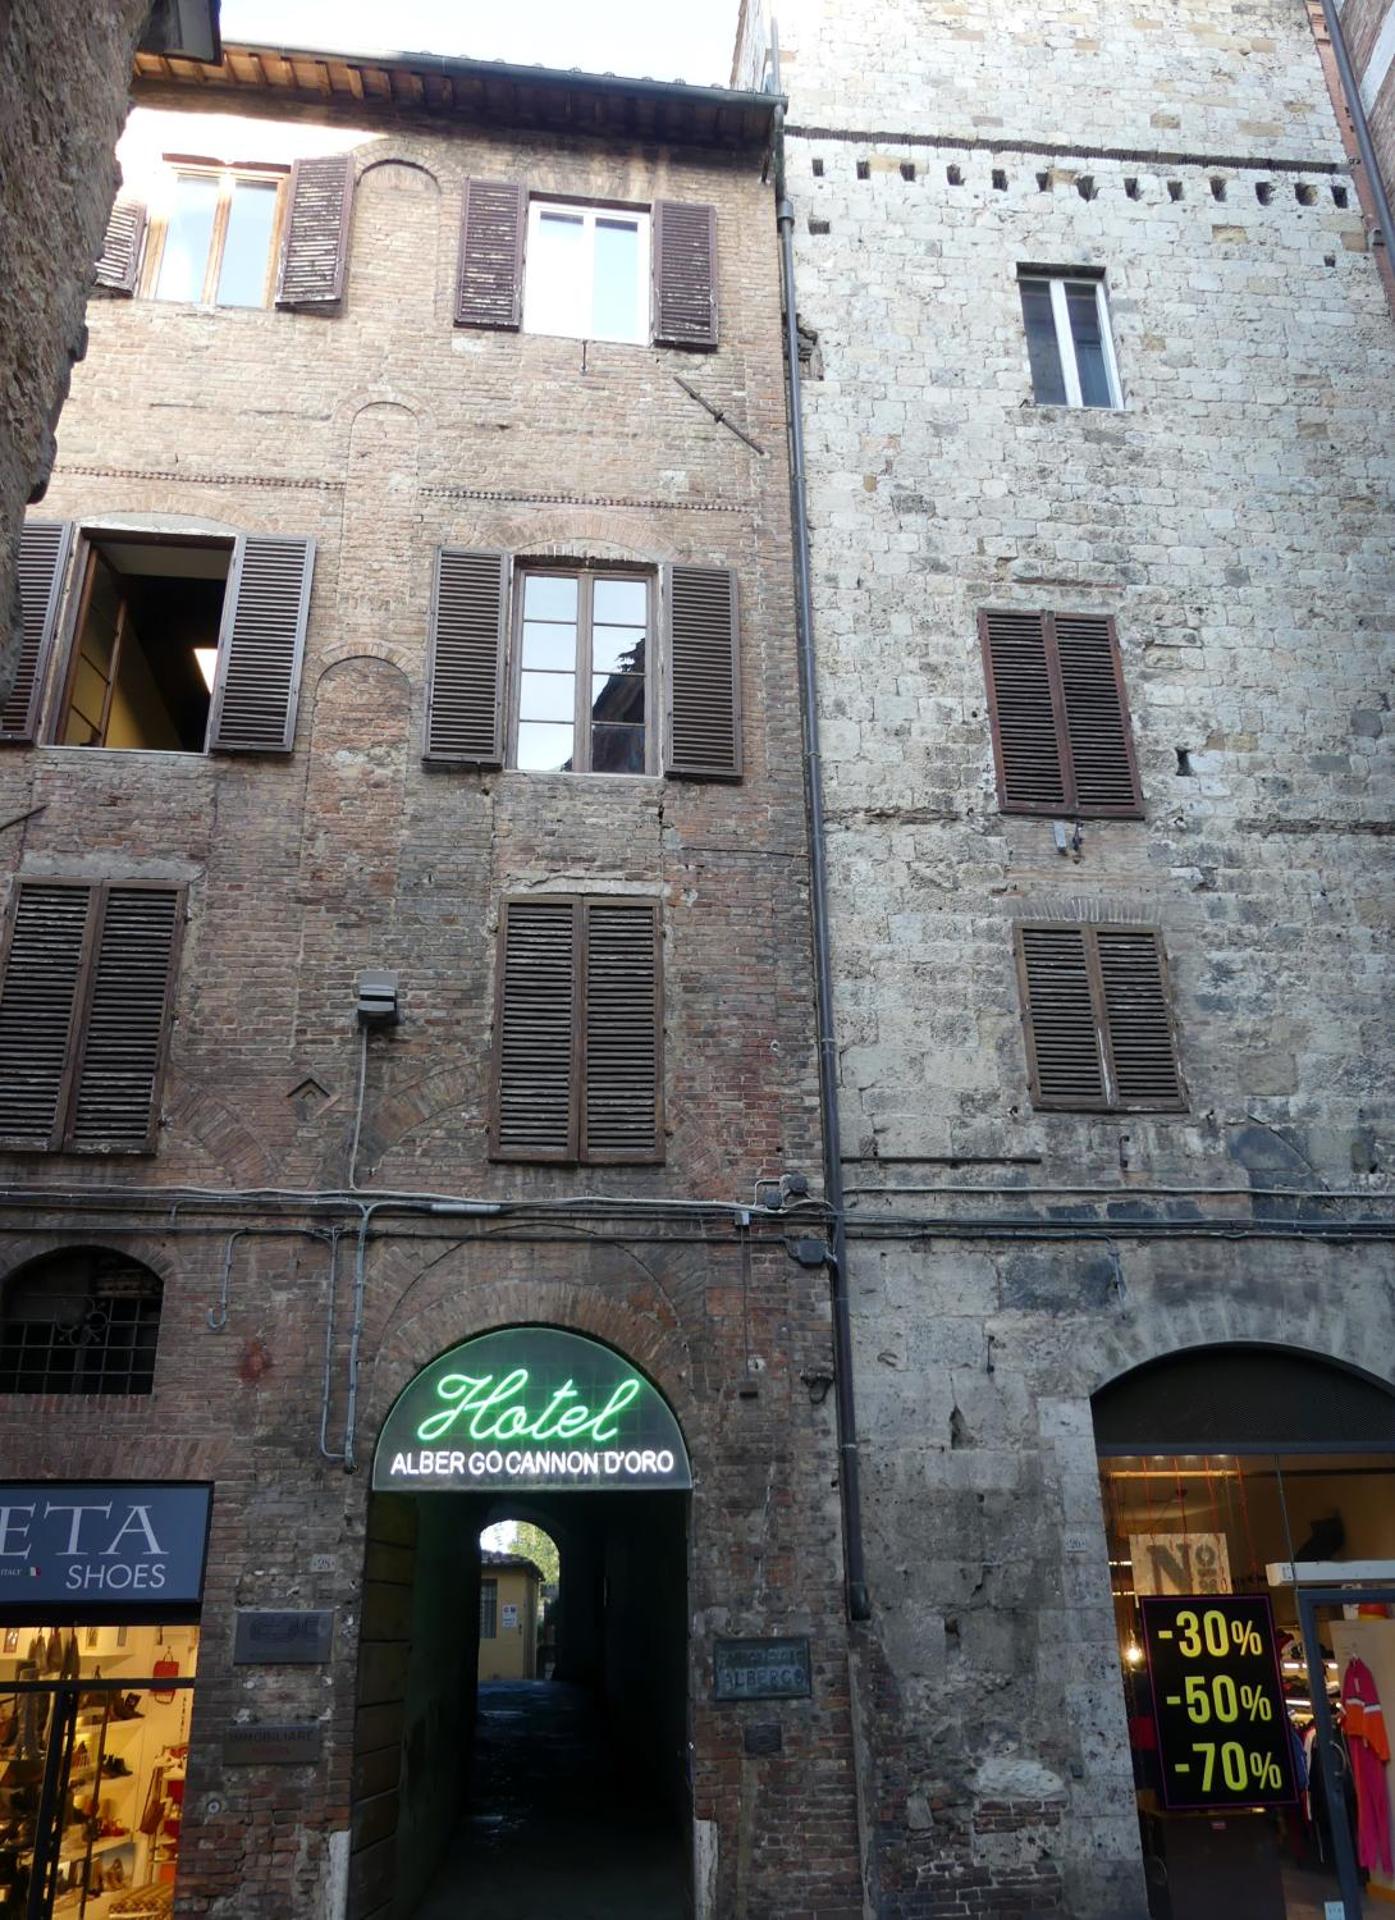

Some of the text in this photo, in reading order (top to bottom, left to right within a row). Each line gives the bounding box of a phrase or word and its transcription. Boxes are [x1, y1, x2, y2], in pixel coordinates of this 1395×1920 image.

[417, 1368, 640, 1441] Hotel
[390, 1451, 674, 1475] ALBERGO CANNON D'ORO
[66, 1564, 166, 1589] SHOES
[1158, 1609, 1262, 1658] -30%
[720, 1668, 804, 1687] ALBERGO
[1166, 1674, 1272, 1724] -50%
[1174, 1741, 1282, 1792] -70%
